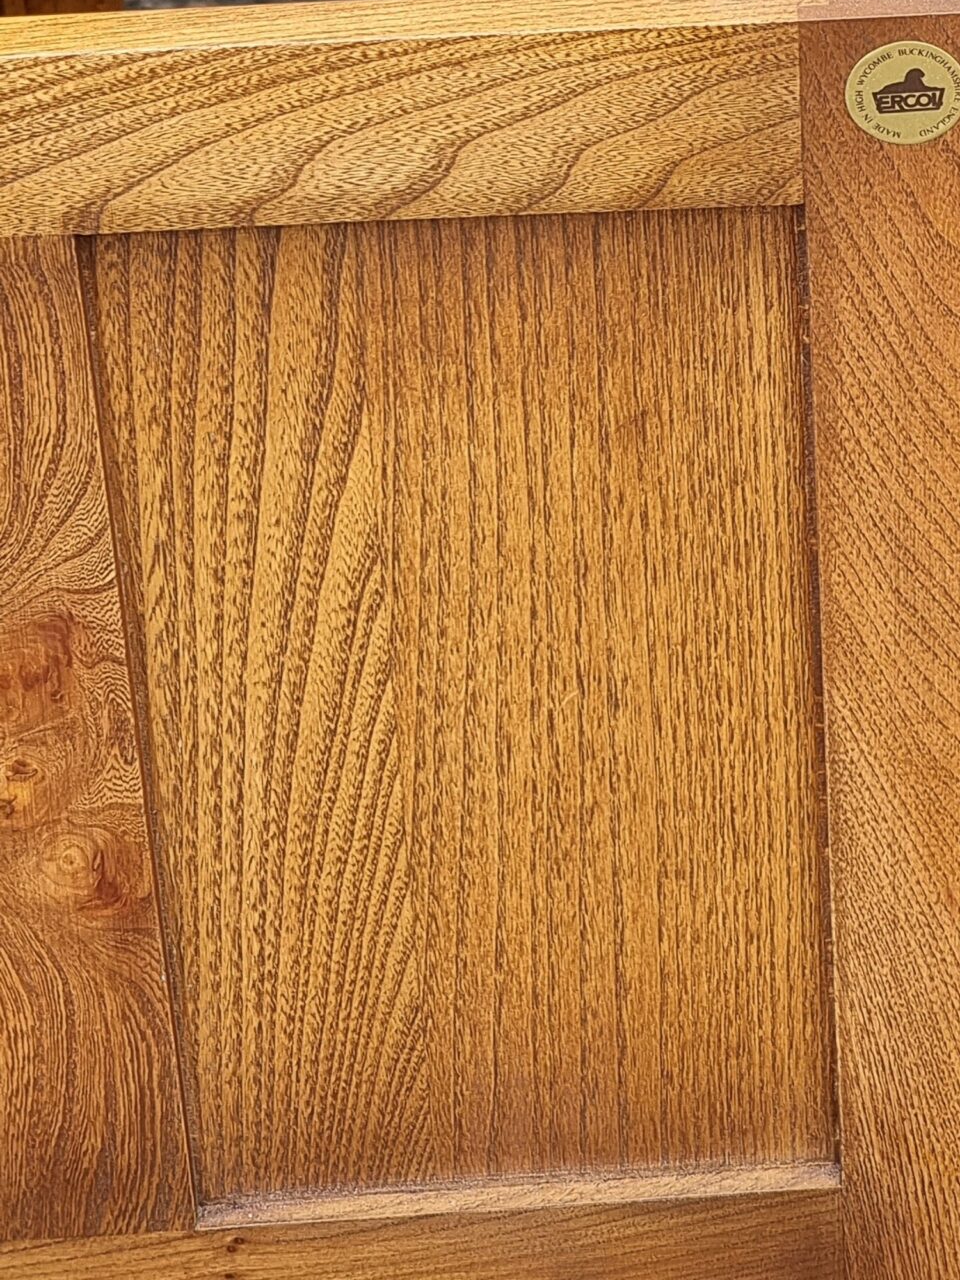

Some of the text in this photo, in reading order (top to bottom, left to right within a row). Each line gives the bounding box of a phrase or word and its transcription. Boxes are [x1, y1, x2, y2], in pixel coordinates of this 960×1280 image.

[857, 51, 894, 86] WYCOMBE
[855, 90, 866, 112] HIGH
[863, 113, 875, 125] IN
[919, 106, 959, 137] ENGLAND
[872, 123, 902, 139] MADE
